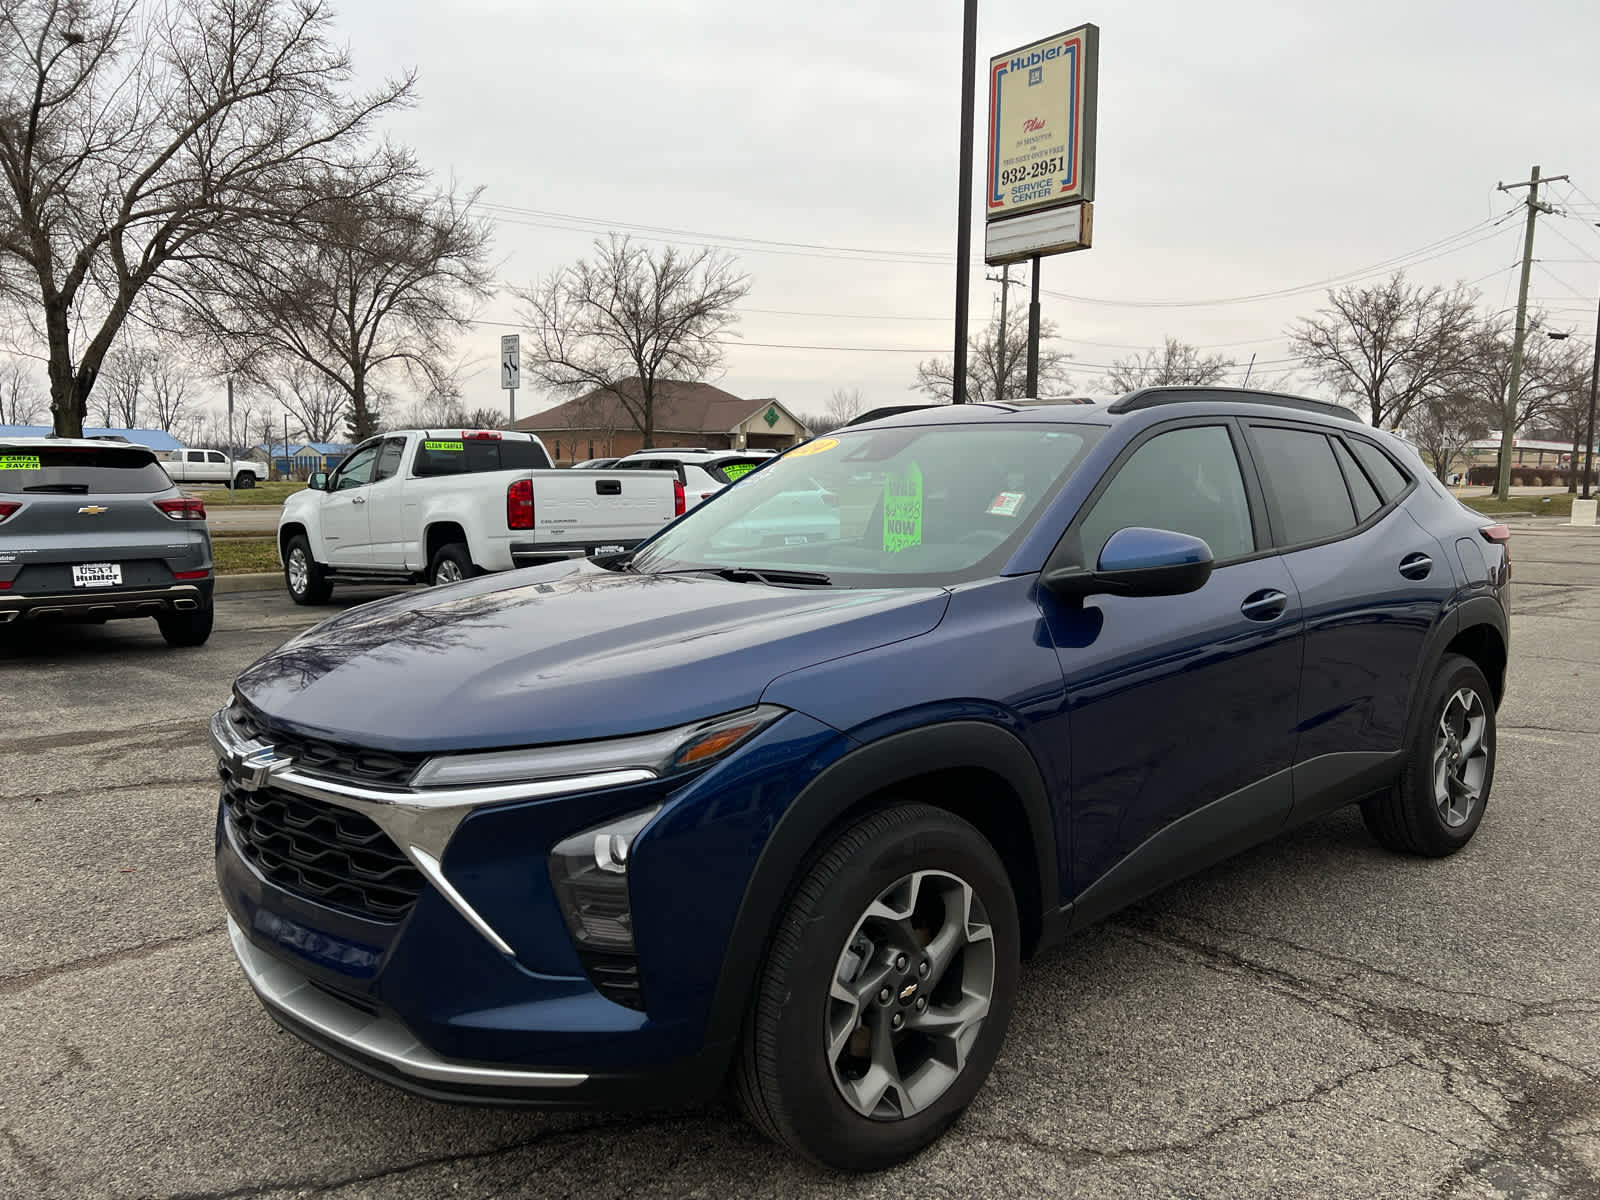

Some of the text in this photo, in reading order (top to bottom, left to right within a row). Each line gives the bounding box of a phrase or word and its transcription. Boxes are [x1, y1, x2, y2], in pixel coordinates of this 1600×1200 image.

[1010, 46, 1062, 72] Hubler
[1023, 117, 1047, 134] Plus
[1001, 155, 1065, 186] 932-2951
[1011, 178, 1053, 195] SERVICE
[1012, 187, 1051, 204] CENTER
[887, 519, 916, 536] NOW
[75, 574, 119, 582] Hubler
[80, 566, 113, 575] USA-1
